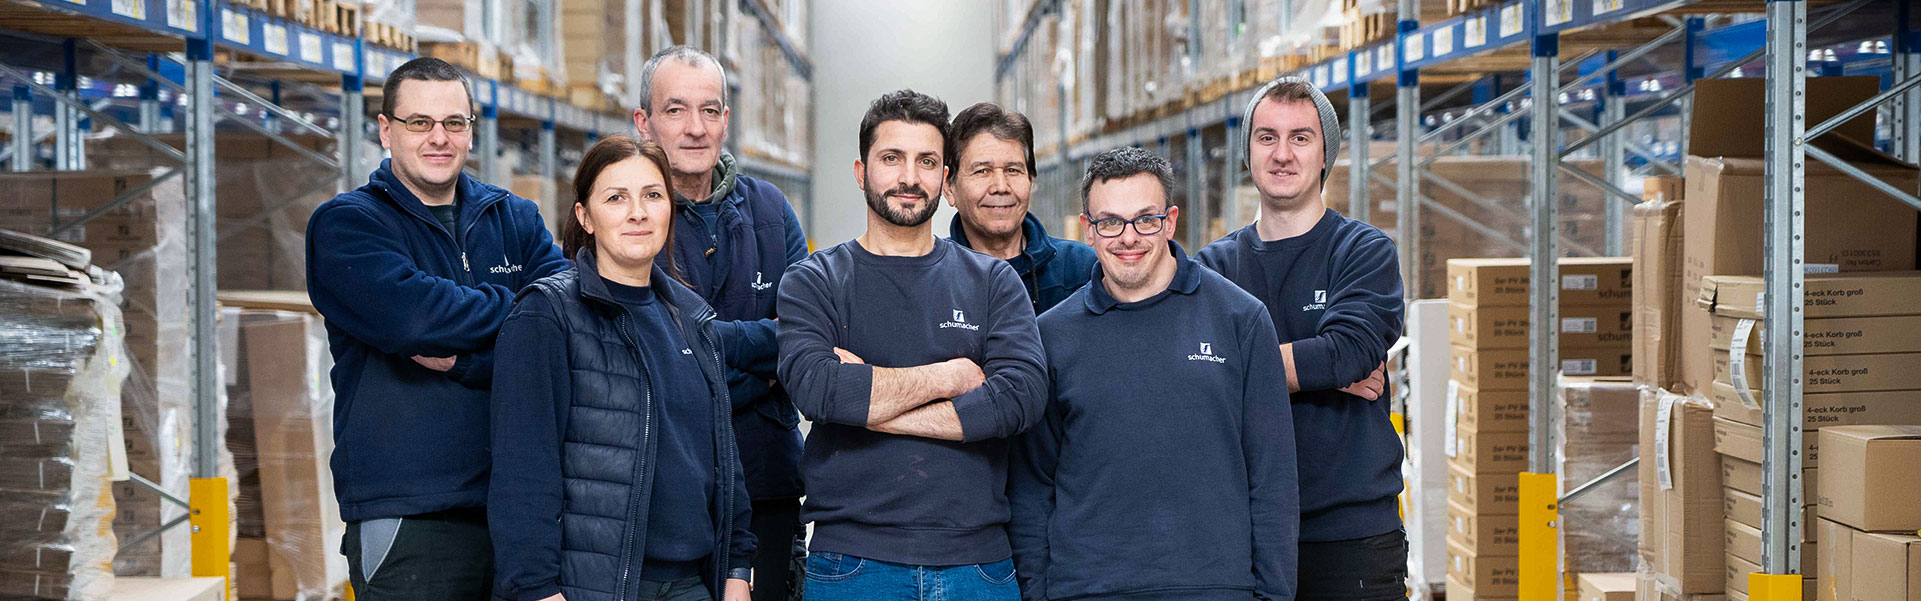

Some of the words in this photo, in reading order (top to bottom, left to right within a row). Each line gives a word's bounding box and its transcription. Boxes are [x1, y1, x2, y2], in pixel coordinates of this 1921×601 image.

[1846, 288, 1864, 297] groß
[939, 320, 980, 330] schumacher
[1846, 330, 1862, 338] groß
[1188, 353, 1226, 364] schumacher
[1851, 368, 1868, 376] groß
[1849, 405, 1866, 414] groß
